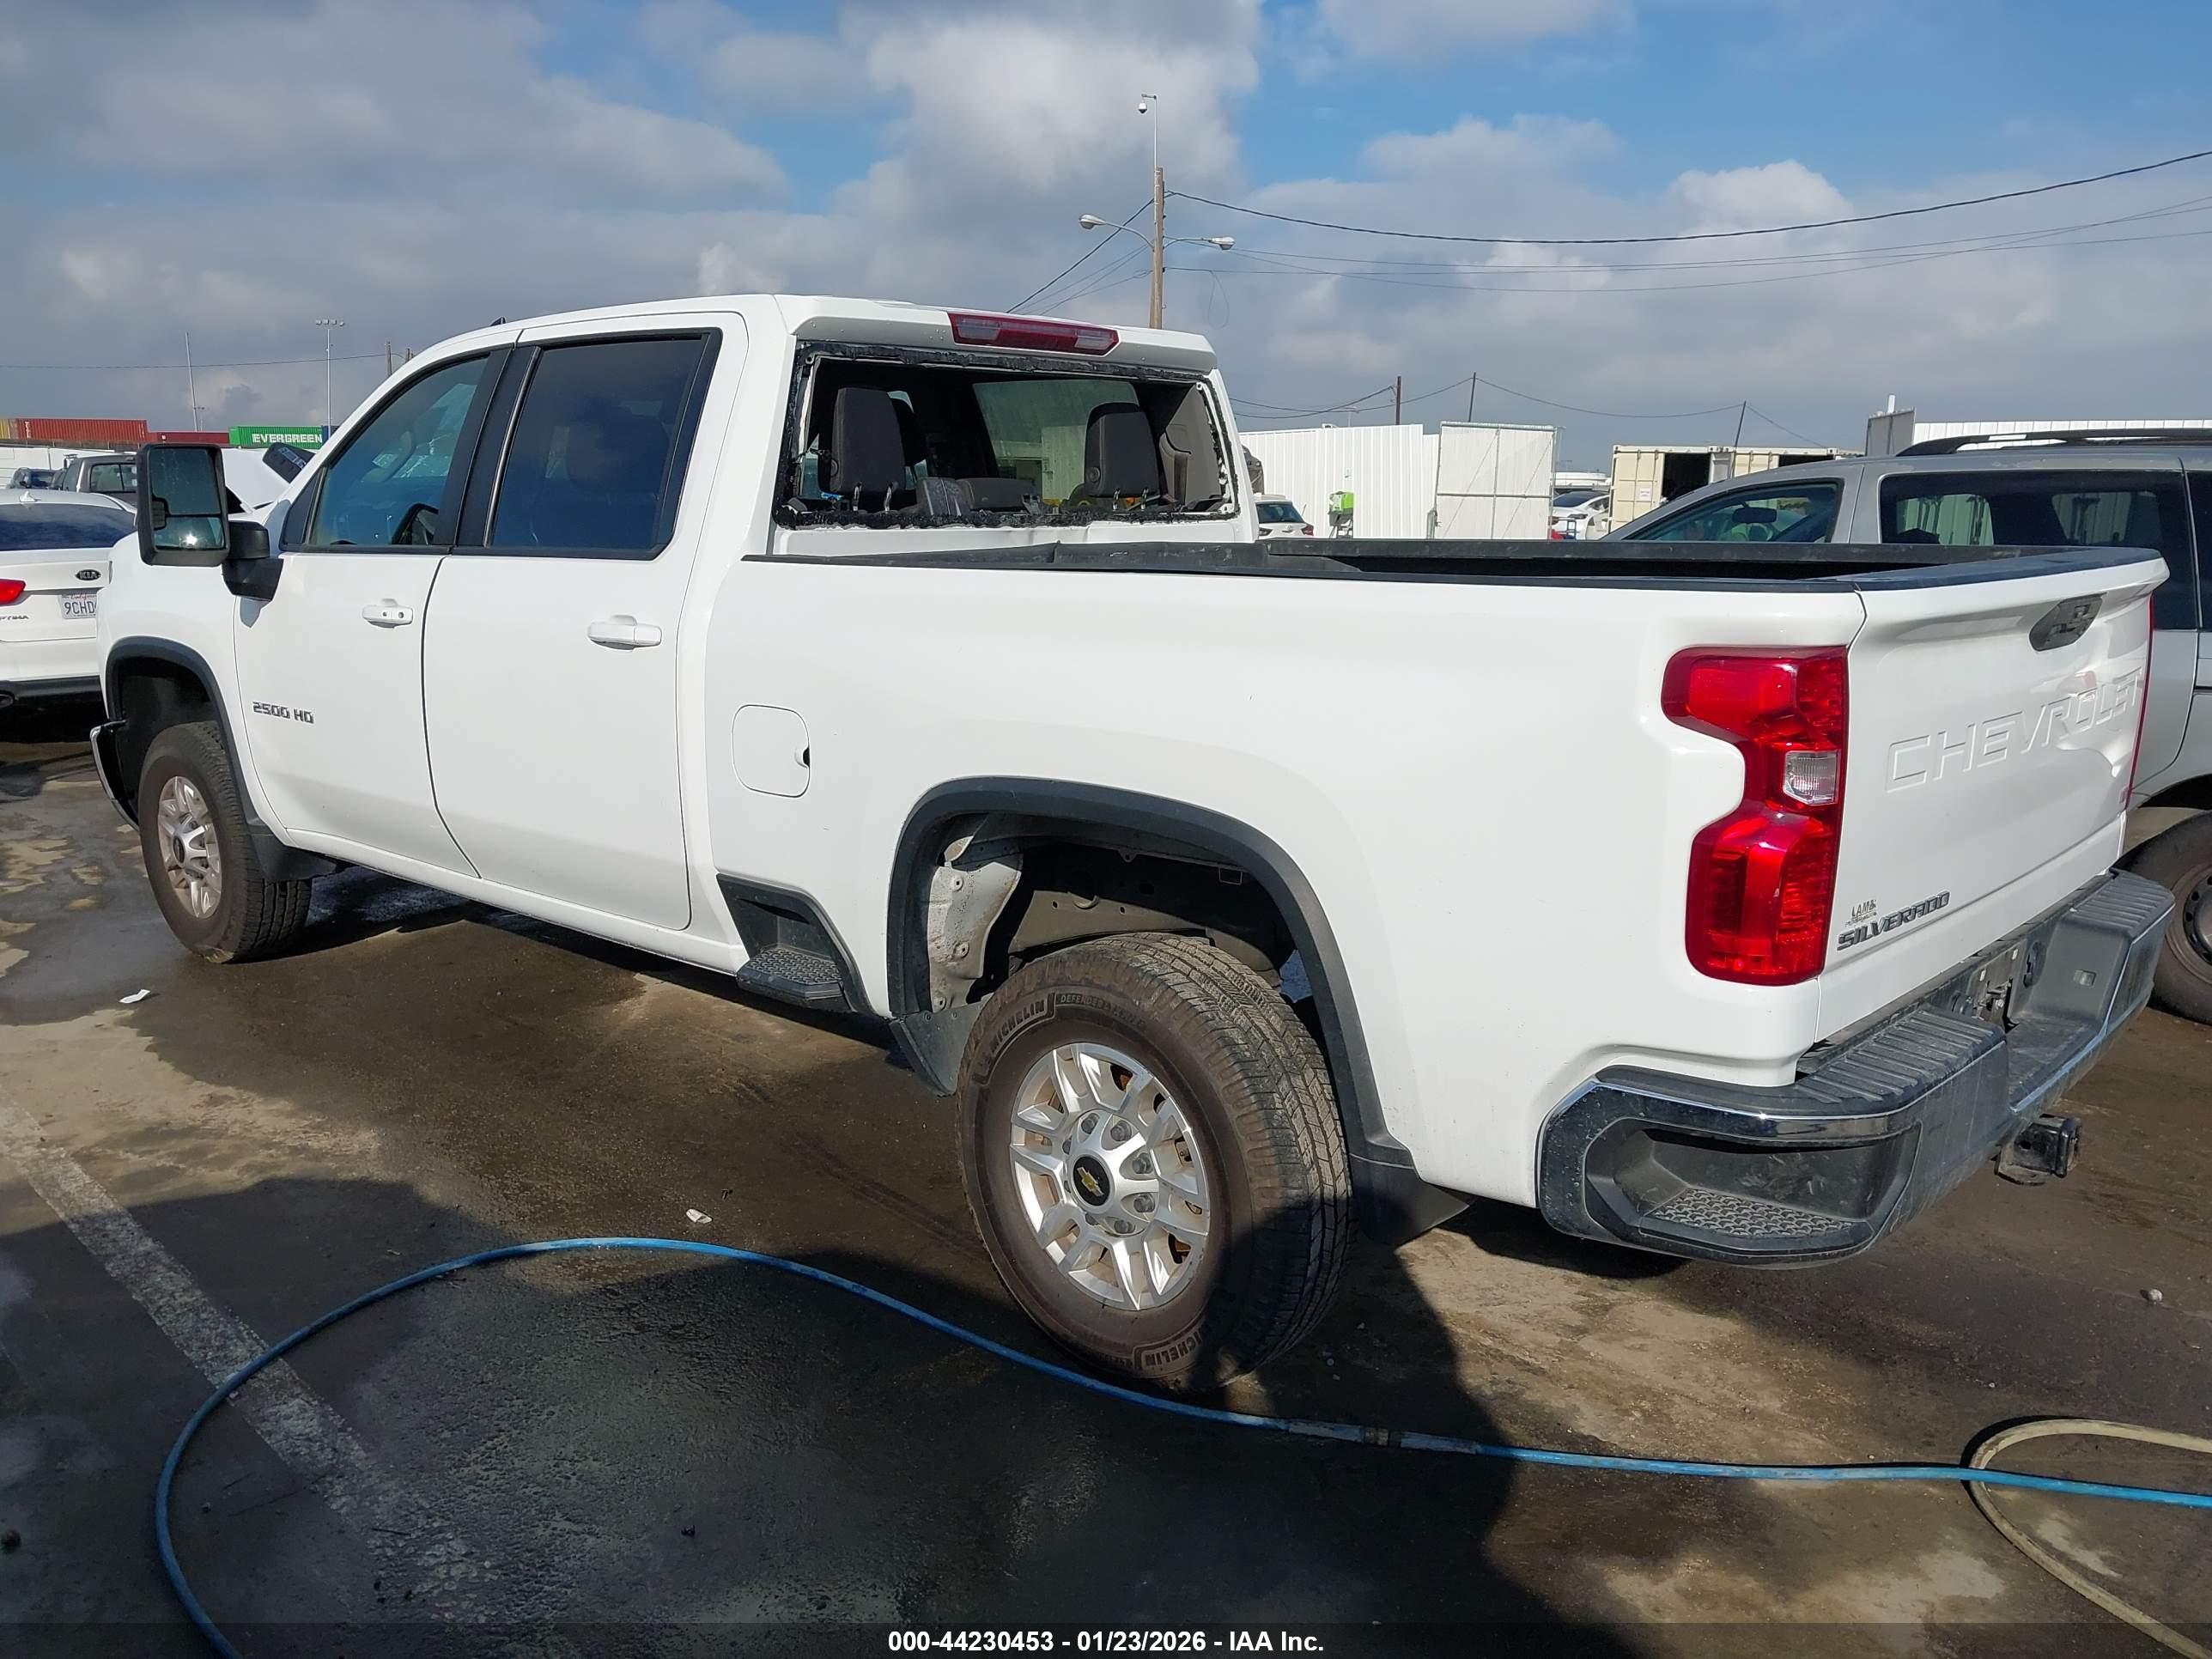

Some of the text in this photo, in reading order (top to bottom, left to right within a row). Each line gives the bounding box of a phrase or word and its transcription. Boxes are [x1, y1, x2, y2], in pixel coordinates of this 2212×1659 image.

[252, 433, 322, 444] EVERGREEN
[252, 701, 314, 725] 2500 HD
[1886, 666, 2142, 793] CHEVROLET
[1836, 890, 1950, 952] SILVERADO
